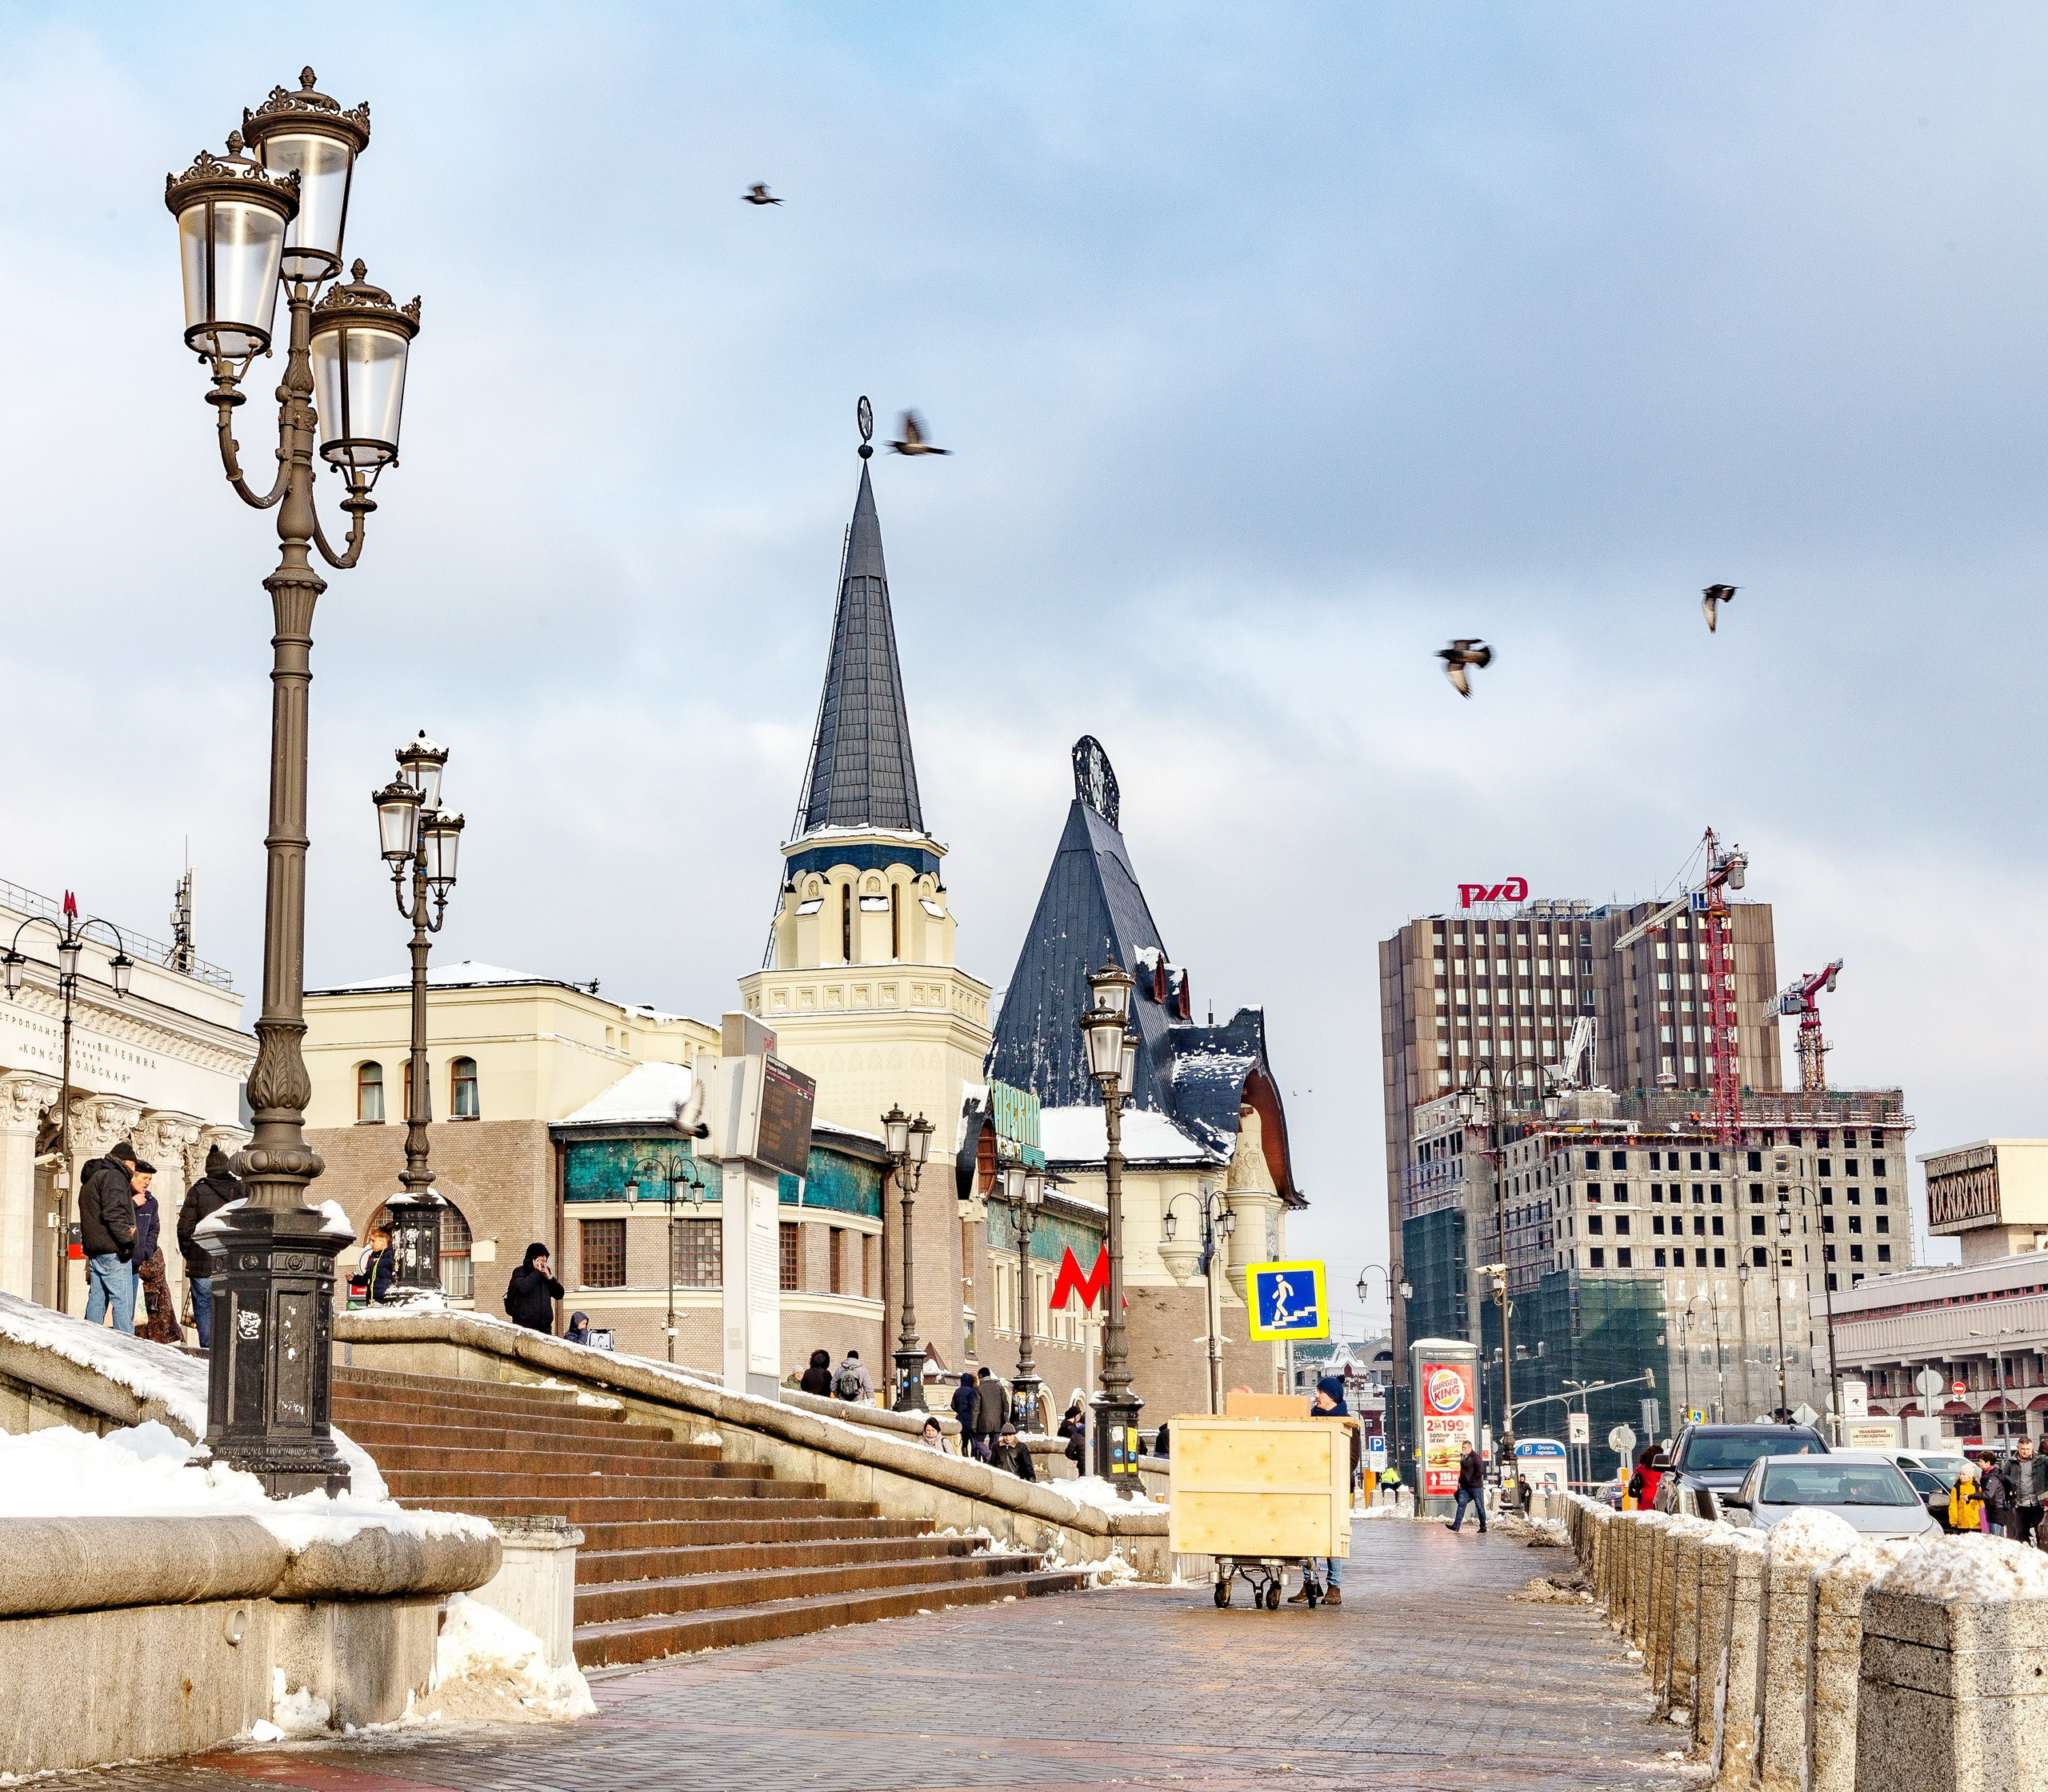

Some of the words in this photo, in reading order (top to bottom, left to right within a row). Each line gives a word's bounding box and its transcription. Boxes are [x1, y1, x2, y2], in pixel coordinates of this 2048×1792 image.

[0, 1012, 64, 1040] ЕТРОПОЛИТЕ
[987, 1077, 1041, 1149] АВСКИЙ
[1433, 1378, 1458, 1393] BURGER
[1434, 1385, 1460, 1402] KING
[1426, 1419, 1434, 1431] 2
[1439, 1472, 1452, 1481] 200
